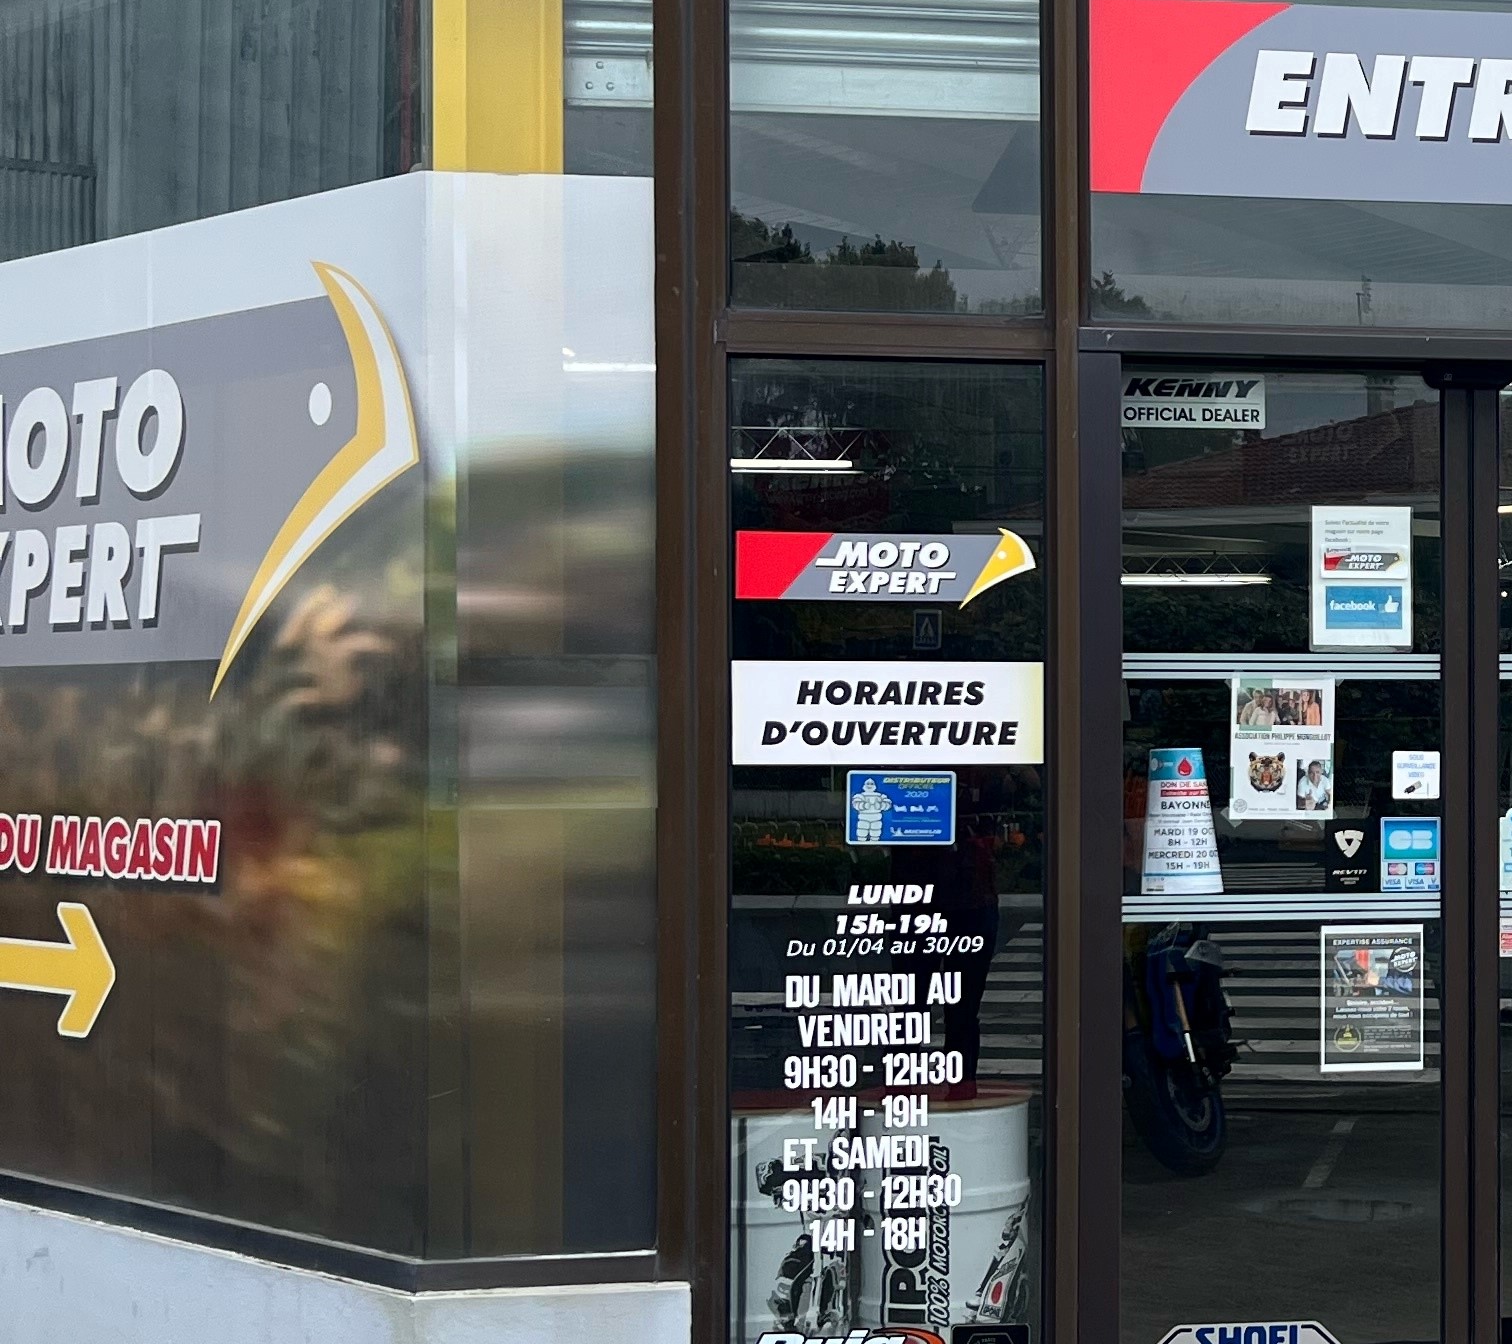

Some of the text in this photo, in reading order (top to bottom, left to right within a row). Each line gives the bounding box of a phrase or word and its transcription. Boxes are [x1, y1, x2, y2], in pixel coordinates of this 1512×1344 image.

[1123, 377, 1260, 398] KENNY
[1123, 406, 1260, 423] OFFICIAL DEALER
[0, 368, 185, 508] OTO
[815, 541, 950, 568] MOTO
[1344, 554, 1382, 562] MOTO
[1348, 562, 1384, 570] EXPERT
[0, 513, 201, 640] PERT
[828, 570, 957, 595] EXPERT
[1329, 599, 1376, 611] facebook
[796, 680, 986, 706] HORAIRES
[761, 720, 1020, 746] D'OUVERTURE
[904, 790, 929, 798] 2020
[1160, 800, 1211, 810] BAYONNE
[1153, 828, 1186, 836] MARDI
[1188, 827, 1199, 836] 19
[1167, 838, 1208, 846] 8H 12H
[0, 813, 221, 883] DU MAGASIN
[1147, 850, 1194, 859] MERCREDI
[1196, 850, 1207, 858] 20
[1165, 861, 1210, 870] 15H 19H
[847, 884, 935, 905] LUNDI
[836, 913, 948, 936] 15h-19h
[786, 936, 984, 959] Du 01/04 au 30/09
[1332, 937, 1413, 946] EXPERTISE ASSURANCE
[1391, 951, 1416, 962] MOTO
[785, 971, 962, 1008] DU MARDI AU
[798, 1011, 932, 1048] VENDREDI
[783, 1054, 857, 1089] 9H30
[882, 1050, 964, 1086] 12H30
[811, 1096, 857, 1130] 14H
[881, 1094, 929, 1128] 19H
[782, 1134, 929, 1172] ET SAMEDI
[933, 1144, 949, 1173] OIL
[781, 1178, 855, 1212] 9H30
[881, 1173, 962, 1209] 12H30
[809, 1219, 855, 1252] 14H
[880, 1216, 926, 1251] 18H
